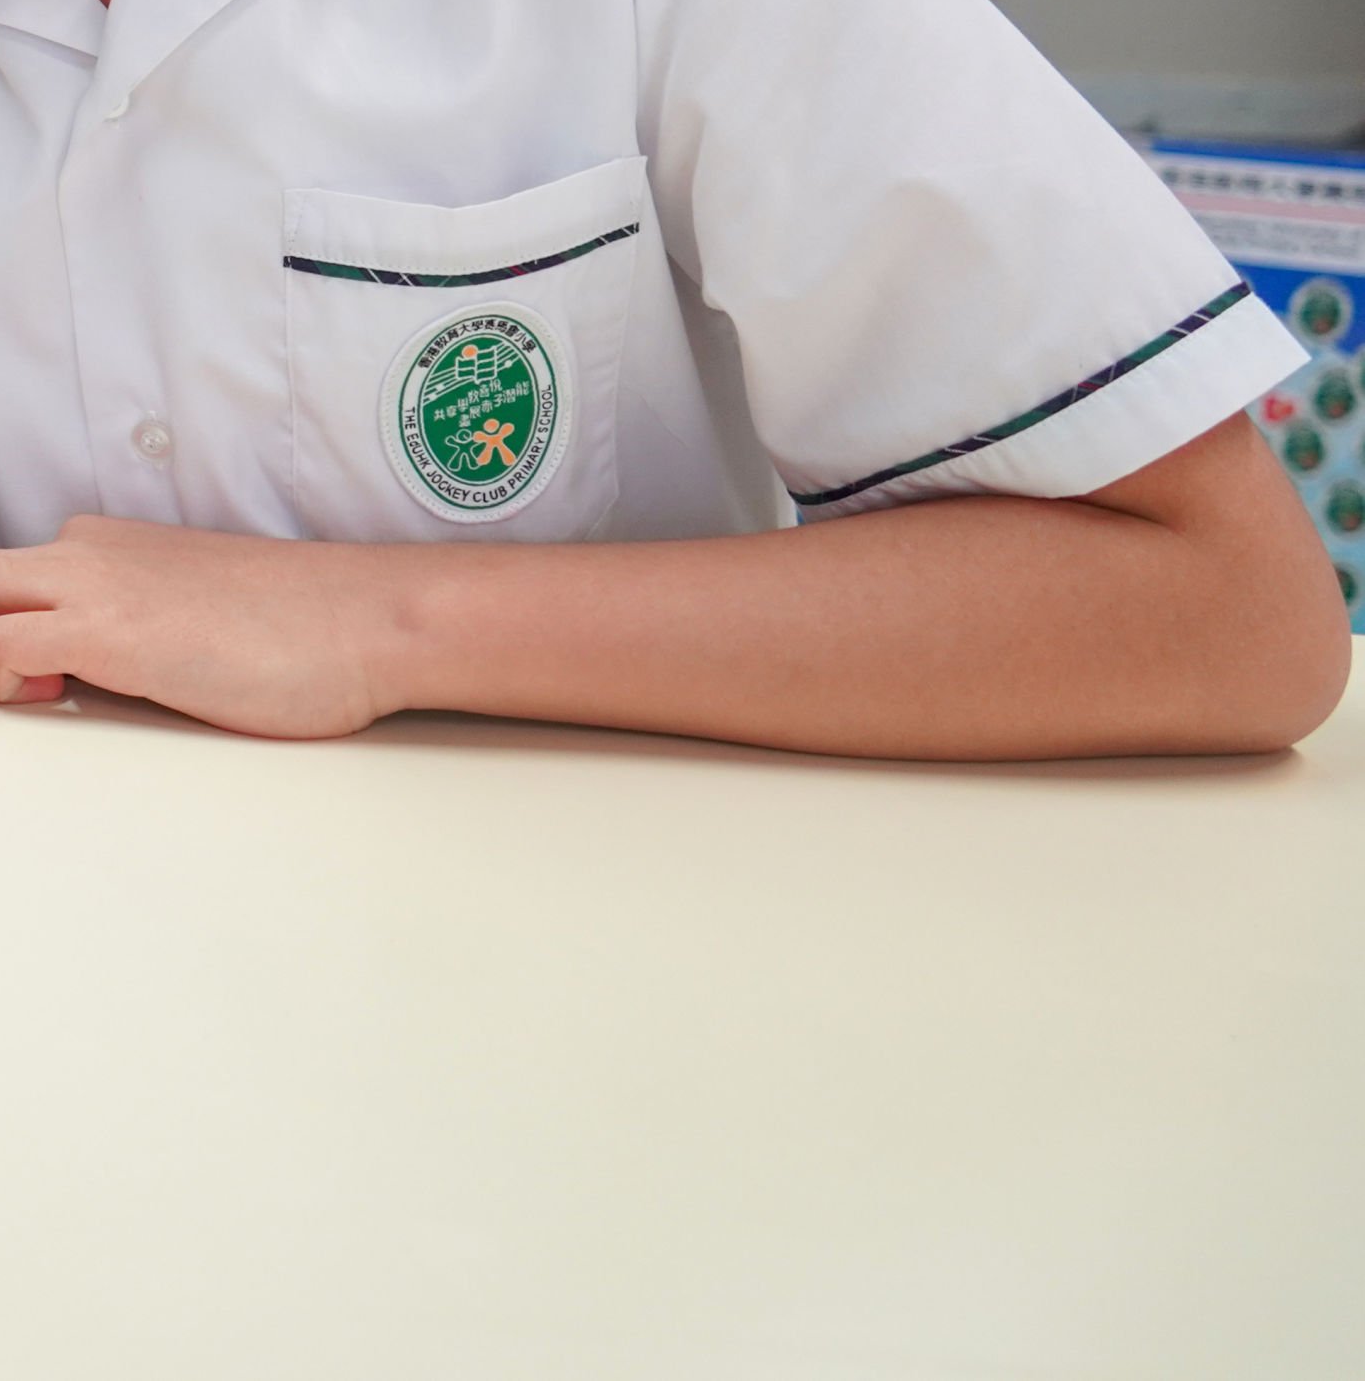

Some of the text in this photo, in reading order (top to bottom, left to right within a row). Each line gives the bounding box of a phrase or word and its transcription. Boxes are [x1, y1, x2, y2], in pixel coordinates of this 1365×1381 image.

[403, 407, 417, 430] THE
[426, 470, 471, 502] JOCKEY
[472, 486, 509, 504] CLUB
[508, 437, 545, 490] PRIMARY
[537, 384, 554, 434] SCHOOL
